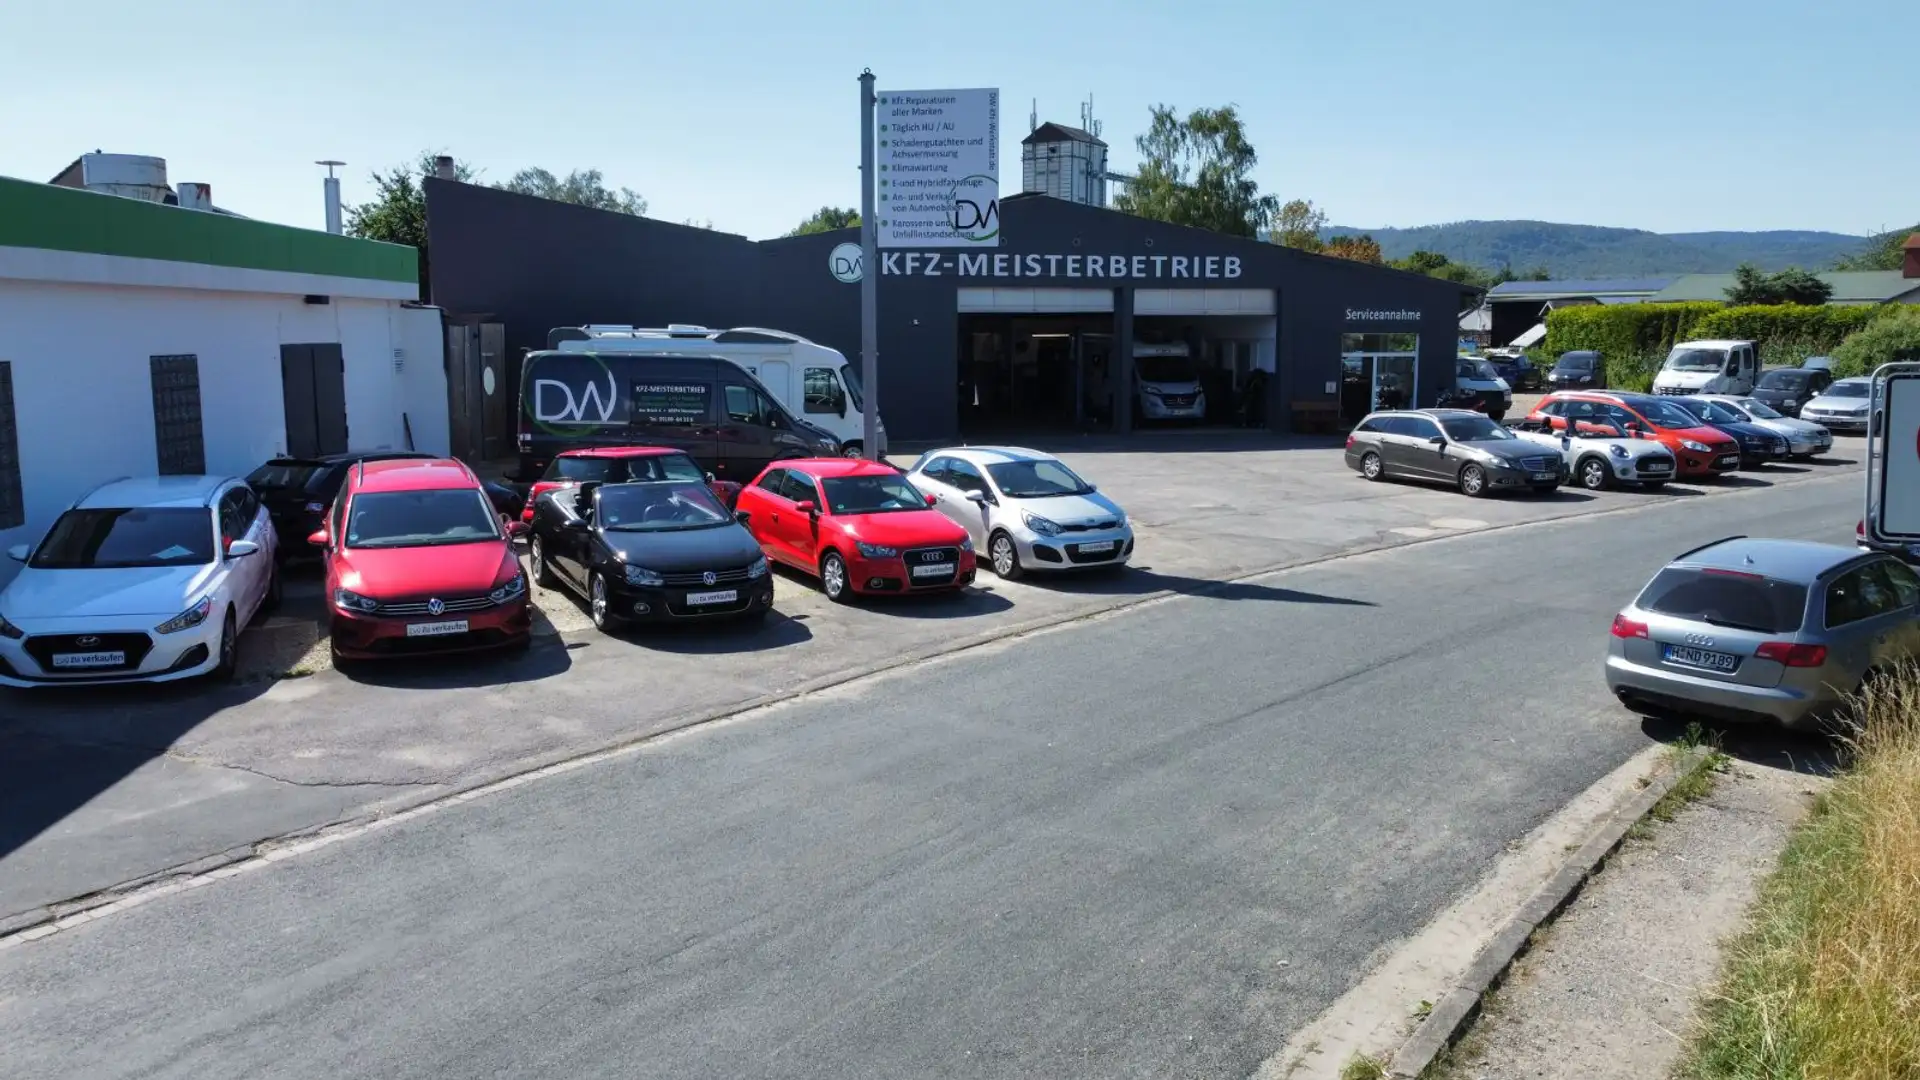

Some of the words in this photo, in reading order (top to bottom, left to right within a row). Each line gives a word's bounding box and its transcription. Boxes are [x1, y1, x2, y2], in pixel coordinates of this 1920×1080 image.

[906, 96, 956, 105] Reparaturen
[891, 108, 909, 116] aller
[911, 107, 943, 116] Marken
[892, 123, 920, 133] Täglich
[922, 123, 934, 131] HU
[942, 122, 955, 131] AU
[892, 139, 965, 148] Schadengutachten
[967, 137, 983, 146] und
[892, 150, 958, 159] Achsvermessung
[892, 164, 948, 173] Klimawartung
[917, 179, 983, 188] Hybridfahrzeuge
[908, 192, 923, 201] und
[892, 219, 933, 228] Karosserie
[892, 230, 975, 239] Unfallinstandsetzung
[881, 252, 1242, 279] KFZ-MEISTERBETRIEB
[1346, 308, 1421, 320] Serviceannahme
[636, 385, 706, 394] KFZ-MEISTERBETRIEB
[71, 654, 81, 662] zu
[82, 652, 124, 663] verkaufen
[1703, 652, 1734, 668] 9189
